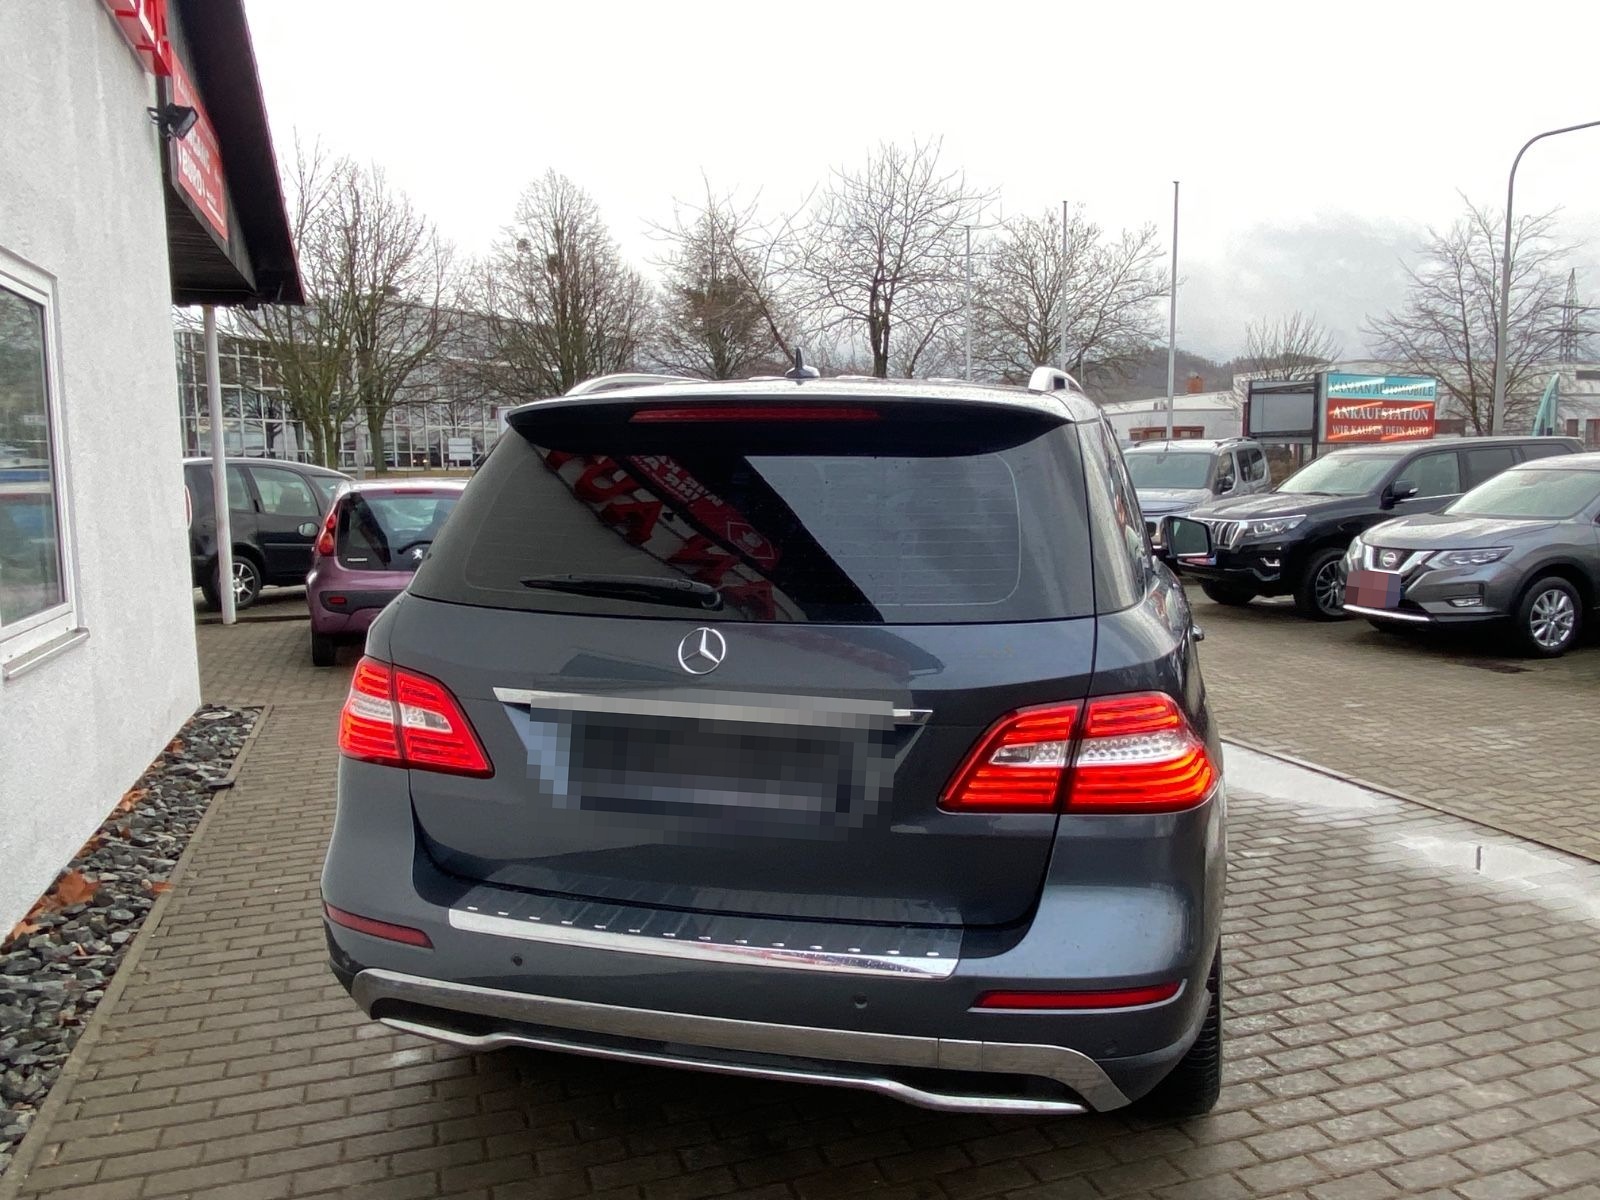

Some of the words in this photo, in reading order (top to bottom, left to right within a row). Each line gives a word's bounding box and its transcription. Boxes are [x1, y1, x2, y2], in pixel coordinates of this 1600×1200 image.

[1373, 384, 1434, 397] AUTOMOBILE
[1332, 406, 1429, 420] ANKAUFSTATION
[1332, 424, 1349, 435] WIR
[1385, 425, 1404, 436] DEIN
[1407, 426, 1429, 436] AUTO
